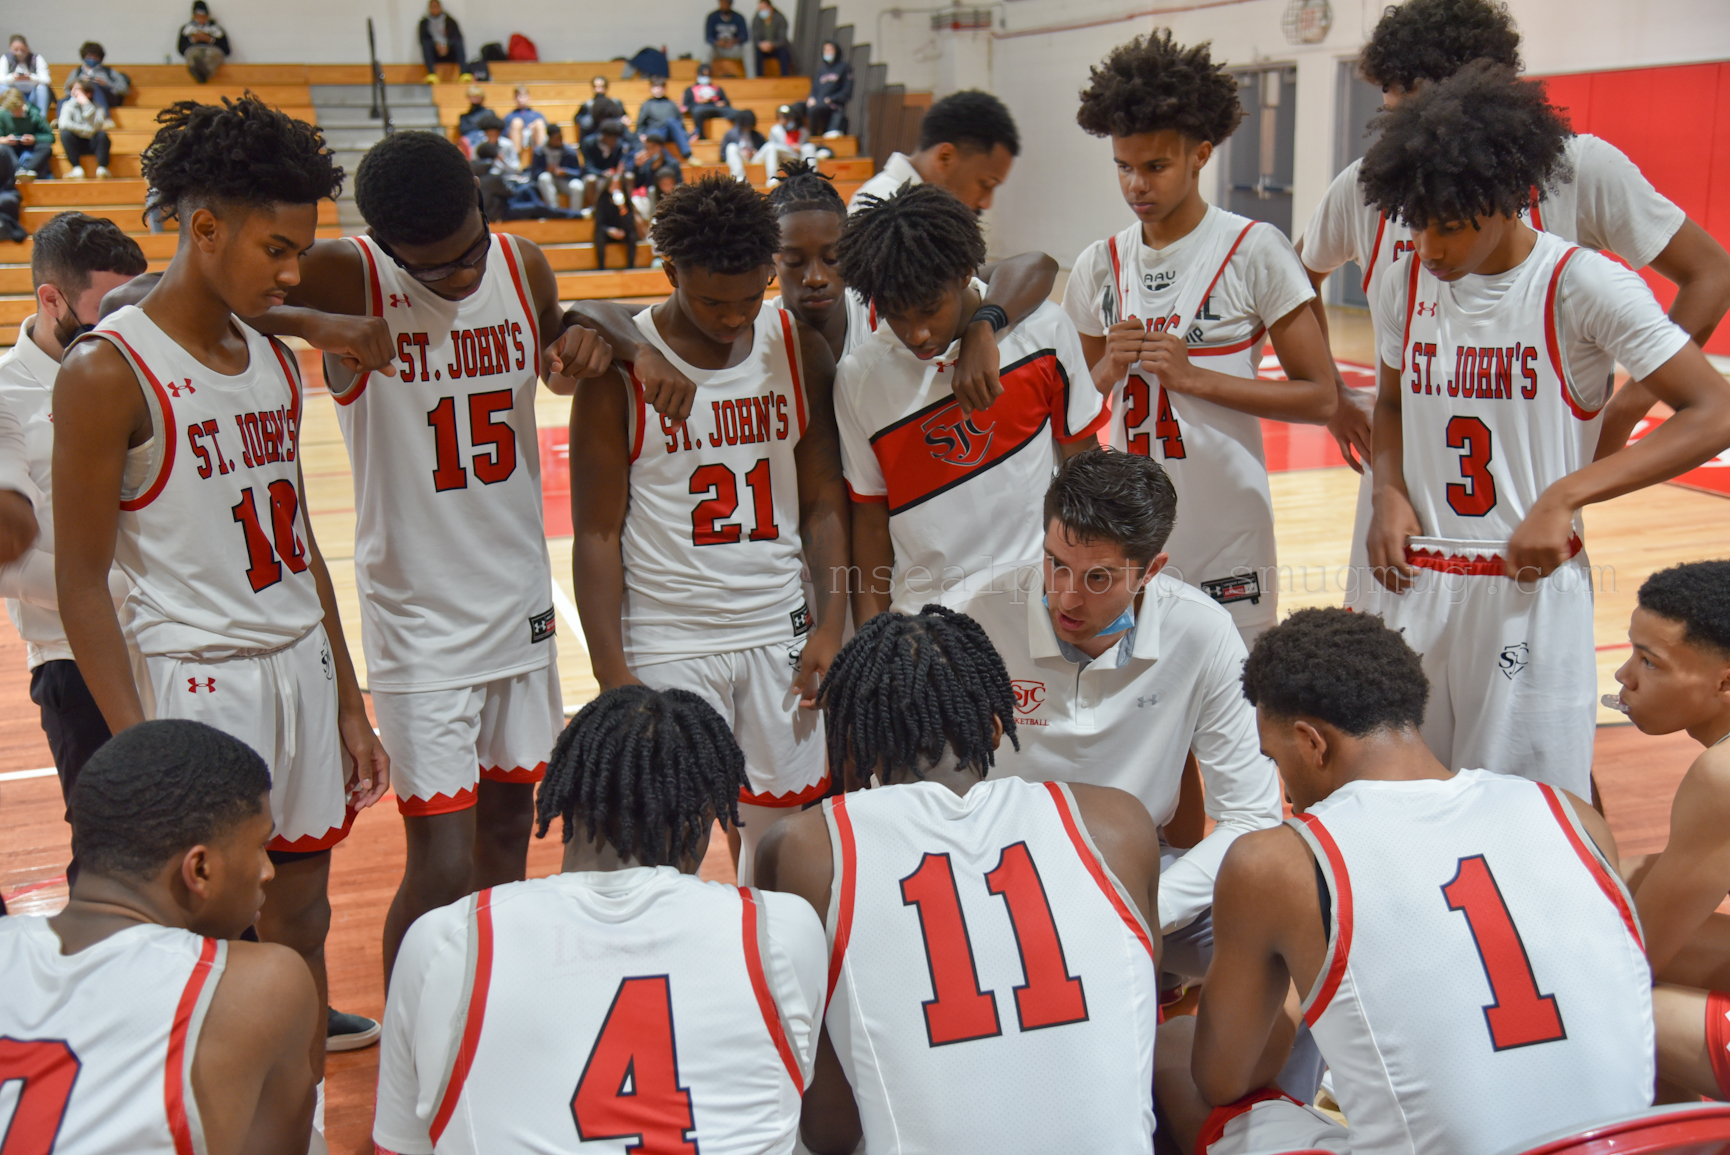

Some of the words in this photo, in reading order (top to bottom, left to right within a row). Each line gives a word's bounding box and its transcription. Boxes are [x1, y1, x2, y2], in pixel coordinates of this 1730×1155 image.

[1143, 270, 1176, 284] AAU
[397, 332, 441, 383] ST.
[448, 319, 525, 379] JOHN'S
[1411, 341, 1441, 396] ST.
[1447, 341, 1538, 400] JOHN'S
[187, 418, 236, 480] ST.
[427, 388, 517, 493] 15
[708, 390, 789, 448] JOHN'S
[1123, 374, 1186, 459] 24
[689, 457, 779, 547] 21
[1446, 415, 1497, 517] 3
[231, 478, 308, 594] 10
[1014, 717, 1049, 726] KETBALL
[899, 840, 1089, 1048] 11
[1439, 853, 1567, 1052] 1
[569, 973, 701, 1155] 4
